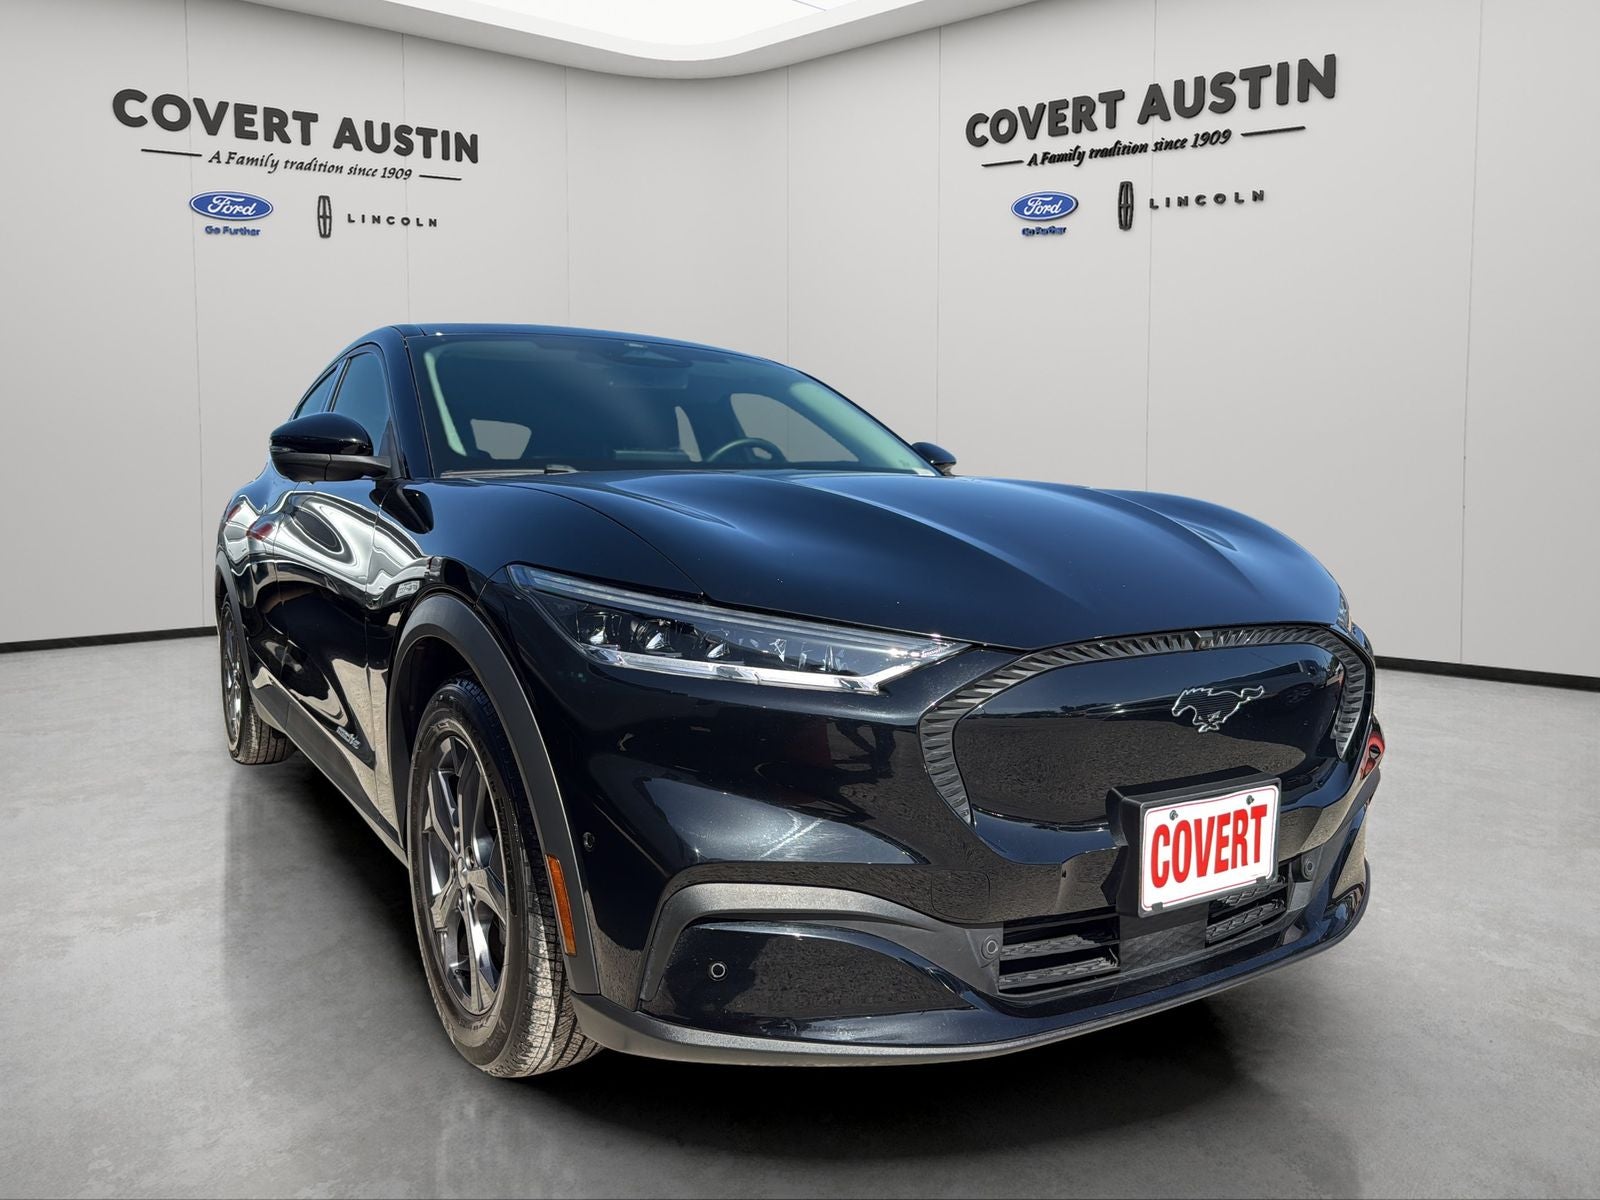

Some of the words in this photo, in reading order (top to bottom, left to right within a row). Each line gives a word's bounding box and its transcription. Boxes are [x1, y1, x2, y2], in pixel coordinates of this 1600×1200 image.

[965, 89, 1126, 148] COVERT
[1137, 54, 1337, 125] AUSTIN
[113, 88, 319, 147] COVERT
[333, 117, 479, 165] AUSTIN
[1026, 152, 1039, 167] A
[1040, 145, 1087, 168] Family
[1089, 139, 1150, 160] tradition
[1152, 136, 1189, 153] since
[1191, 128, 1233, 149] 1909
[208, 150, 222, 164] A
[225, 151, 280, 175] Family
[284, 158, 344, 175] tradition
[347, 163, 379, 178] since
[380, 166, 413, 181] 1909
[207, 195, 257, 216] Ford
[1023, 196, 1063, 216] Ford
[1149, 189, 1265, 211] LINCOLN
[222, 225, 261, 236] Further
[347, 213, 438, 228] LINCOLN
[1150, 804, 1268, 889] COVERT
